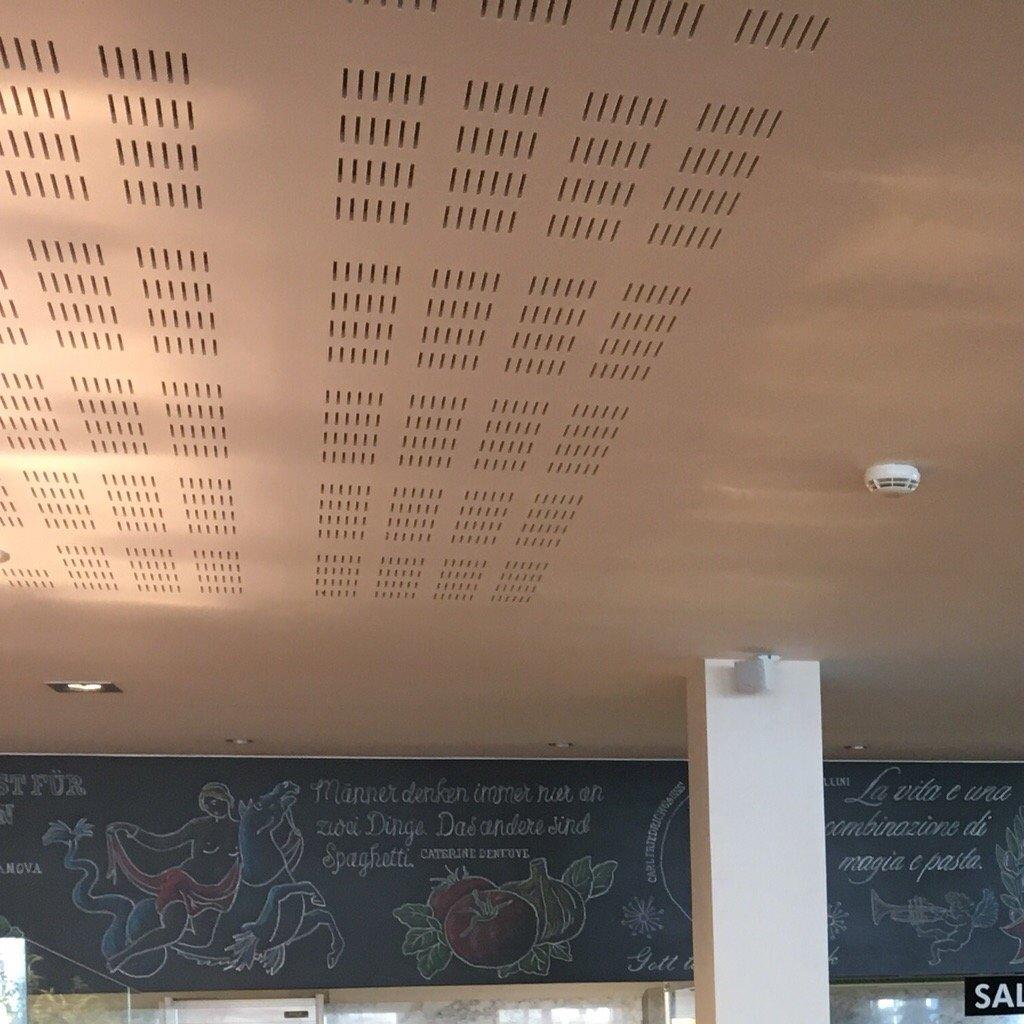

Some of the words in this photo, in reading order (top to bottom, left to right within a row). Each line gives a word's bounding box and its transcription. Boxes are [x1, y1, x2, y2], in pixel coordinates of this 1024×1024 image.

[31, 769, 87, 796] FÜR
[401, 778, 469, 804] denken
[474, 783, 533, 805] immer
[844, 766, 901, 807] La
[893, 777, 942, 801] vita
[964, 784, 1012, 802] una
[316, 816, 358, 837] zwei
[435, 811, 477, 837] Das
[480, 813, 544, 838] andere
[547, 812, 592, 837] sind
[963, 809, 993, 837] di
[838, 850, 906, 884] magia
